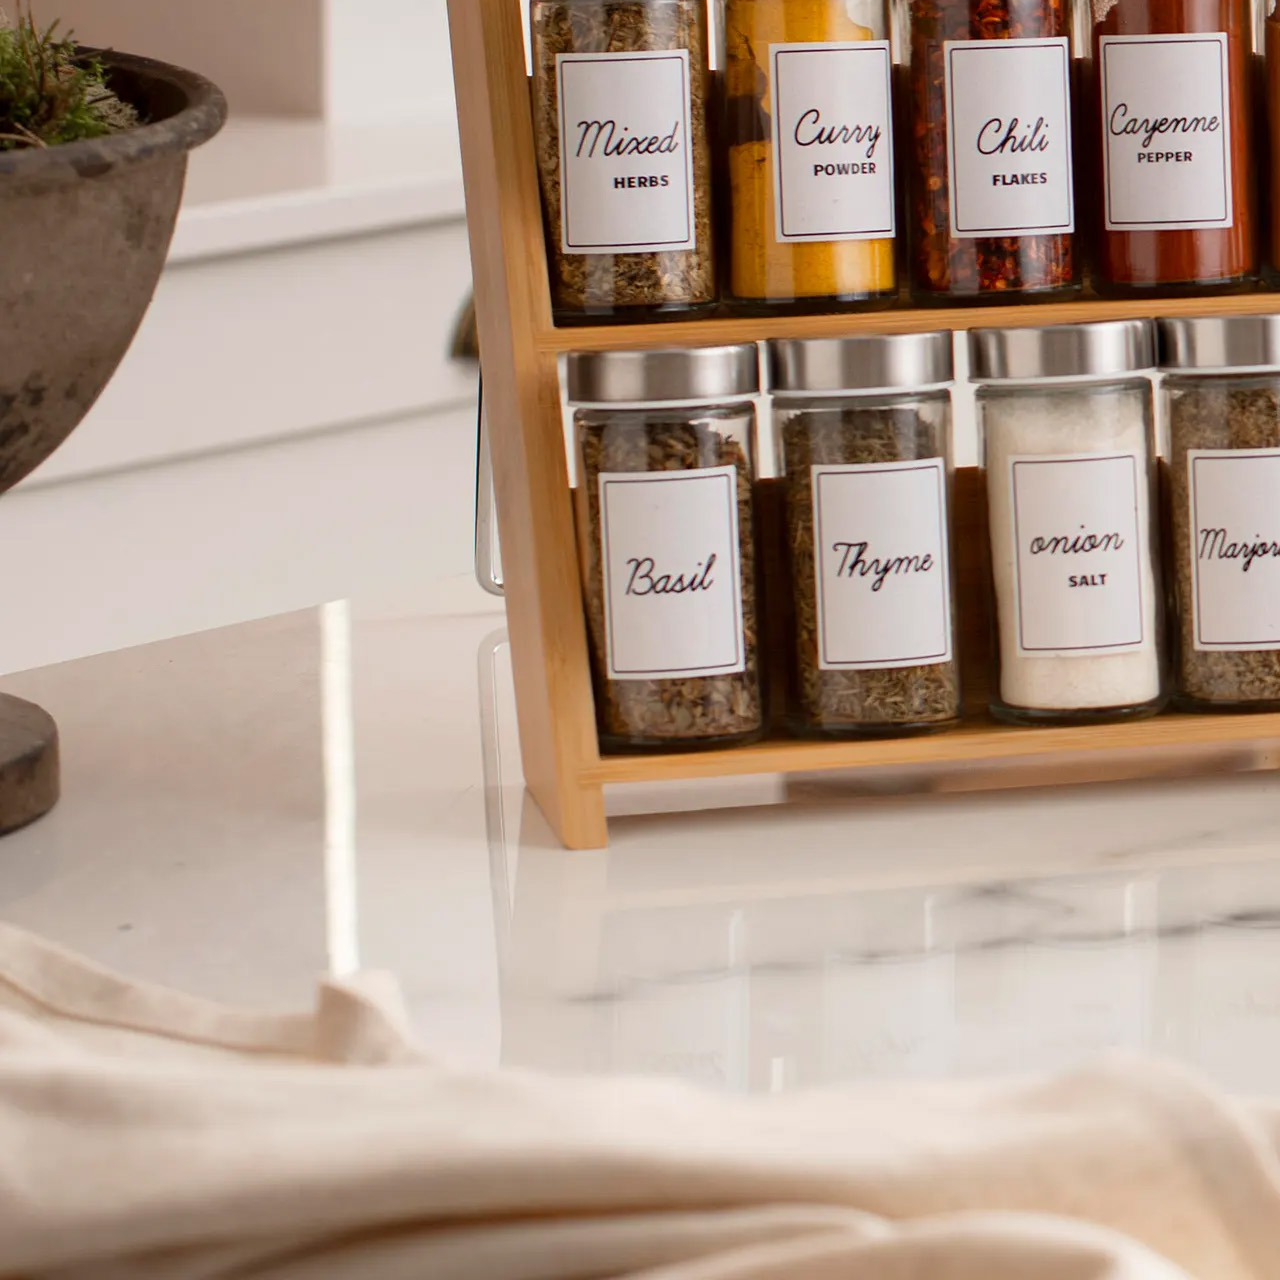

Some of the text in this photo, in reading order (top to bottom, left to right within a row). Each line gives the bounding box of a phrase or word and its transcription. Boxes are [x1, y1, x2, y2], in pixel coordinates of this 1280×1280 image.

[576, 120, 679, 158] Mixed
[794, 109, 881, 158] Curry
[976, 117, 1049, 155] Chili
[1109, 103, 1220, 146] Cayenne
[813, 162, 876, 177] POWDER
[1137, 151, 1193, 164] PEPPER
[613, 174, 669, 189] HERBS
[992, 172, 1047, 186] FLAKES
[1030, 525, 1124, 554] onion
[625, 553, 716, 596] Basil
[833, 541, 934, 592] Thyme
[1068, 573, 1107, 587] SALT
